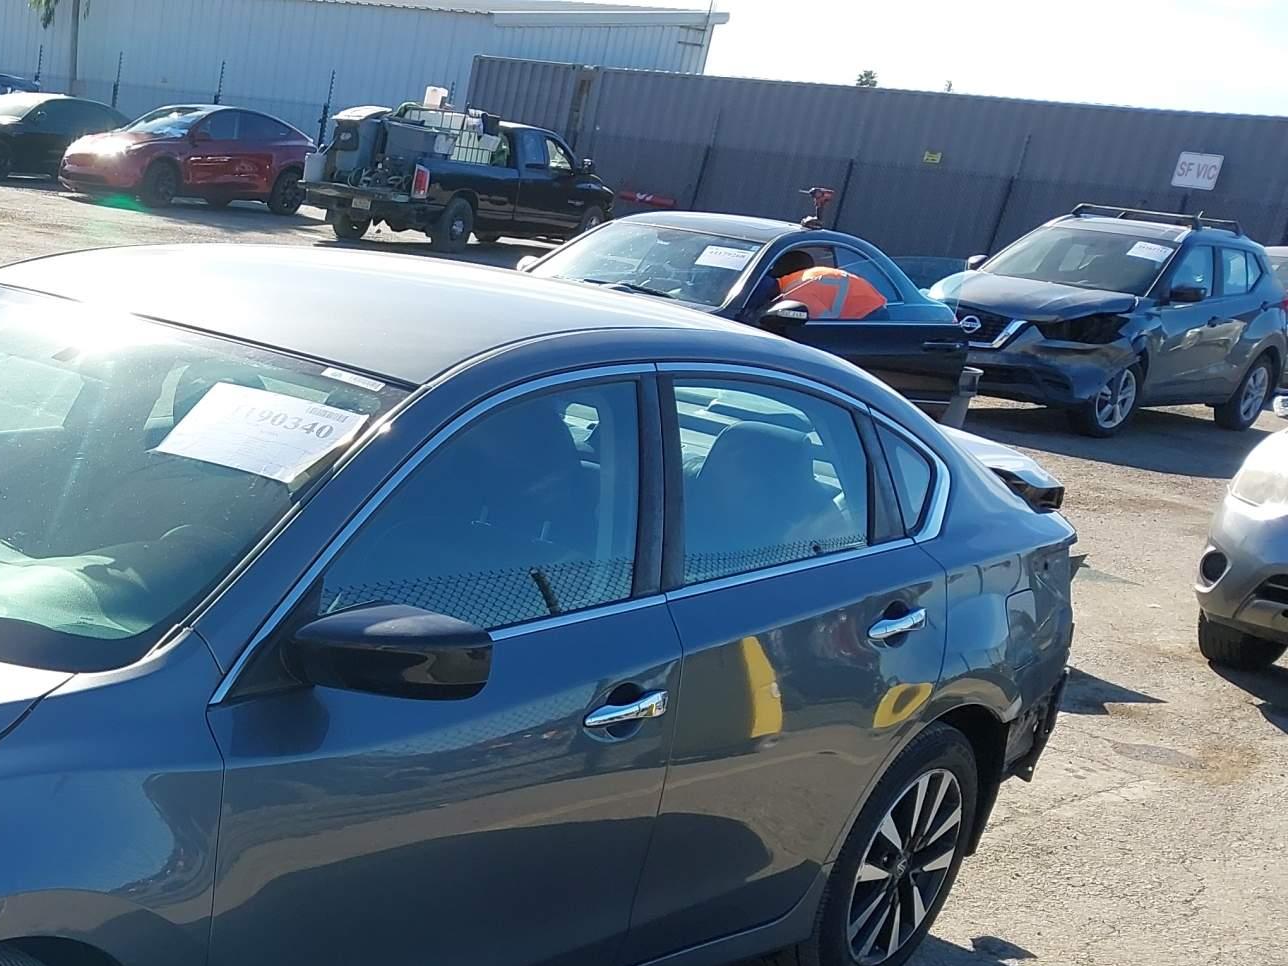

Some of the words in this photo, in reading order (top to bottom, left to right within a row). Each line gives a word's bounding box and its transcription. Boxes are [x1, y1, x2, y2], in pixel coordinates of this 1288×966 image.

[1177, 161, 1195, 176] SF
[1196, 163, 1217, 180] VIC
[232, 405, 334, 439] 190340
